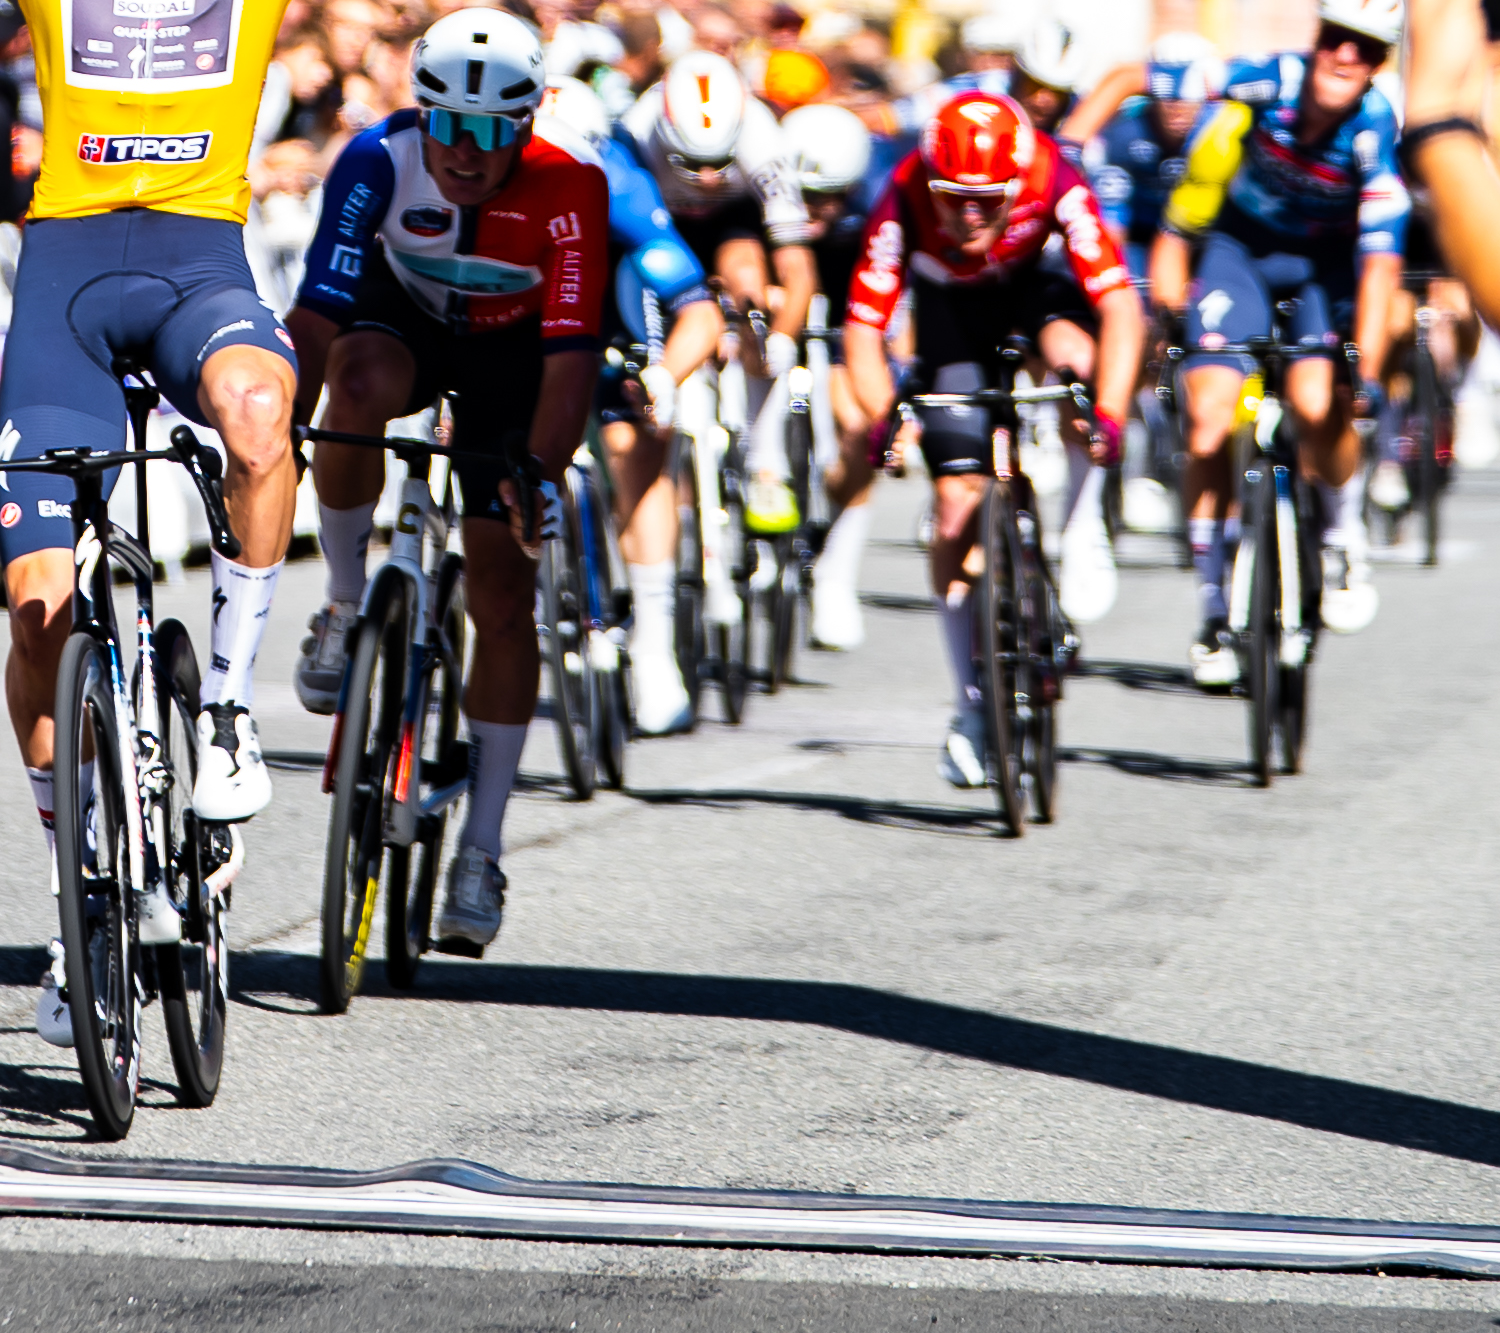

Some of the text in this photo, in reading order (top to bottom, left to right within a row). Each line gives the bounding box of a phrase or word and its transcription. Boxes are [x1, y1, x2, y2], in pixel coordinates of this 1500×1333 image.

[117, 0, 190, 13] SOUDAL
[112, 137, 204, 160] TIPOS
[339, 183, 373, 237] ALITER
[559, 249, 583, 304] ALITER
